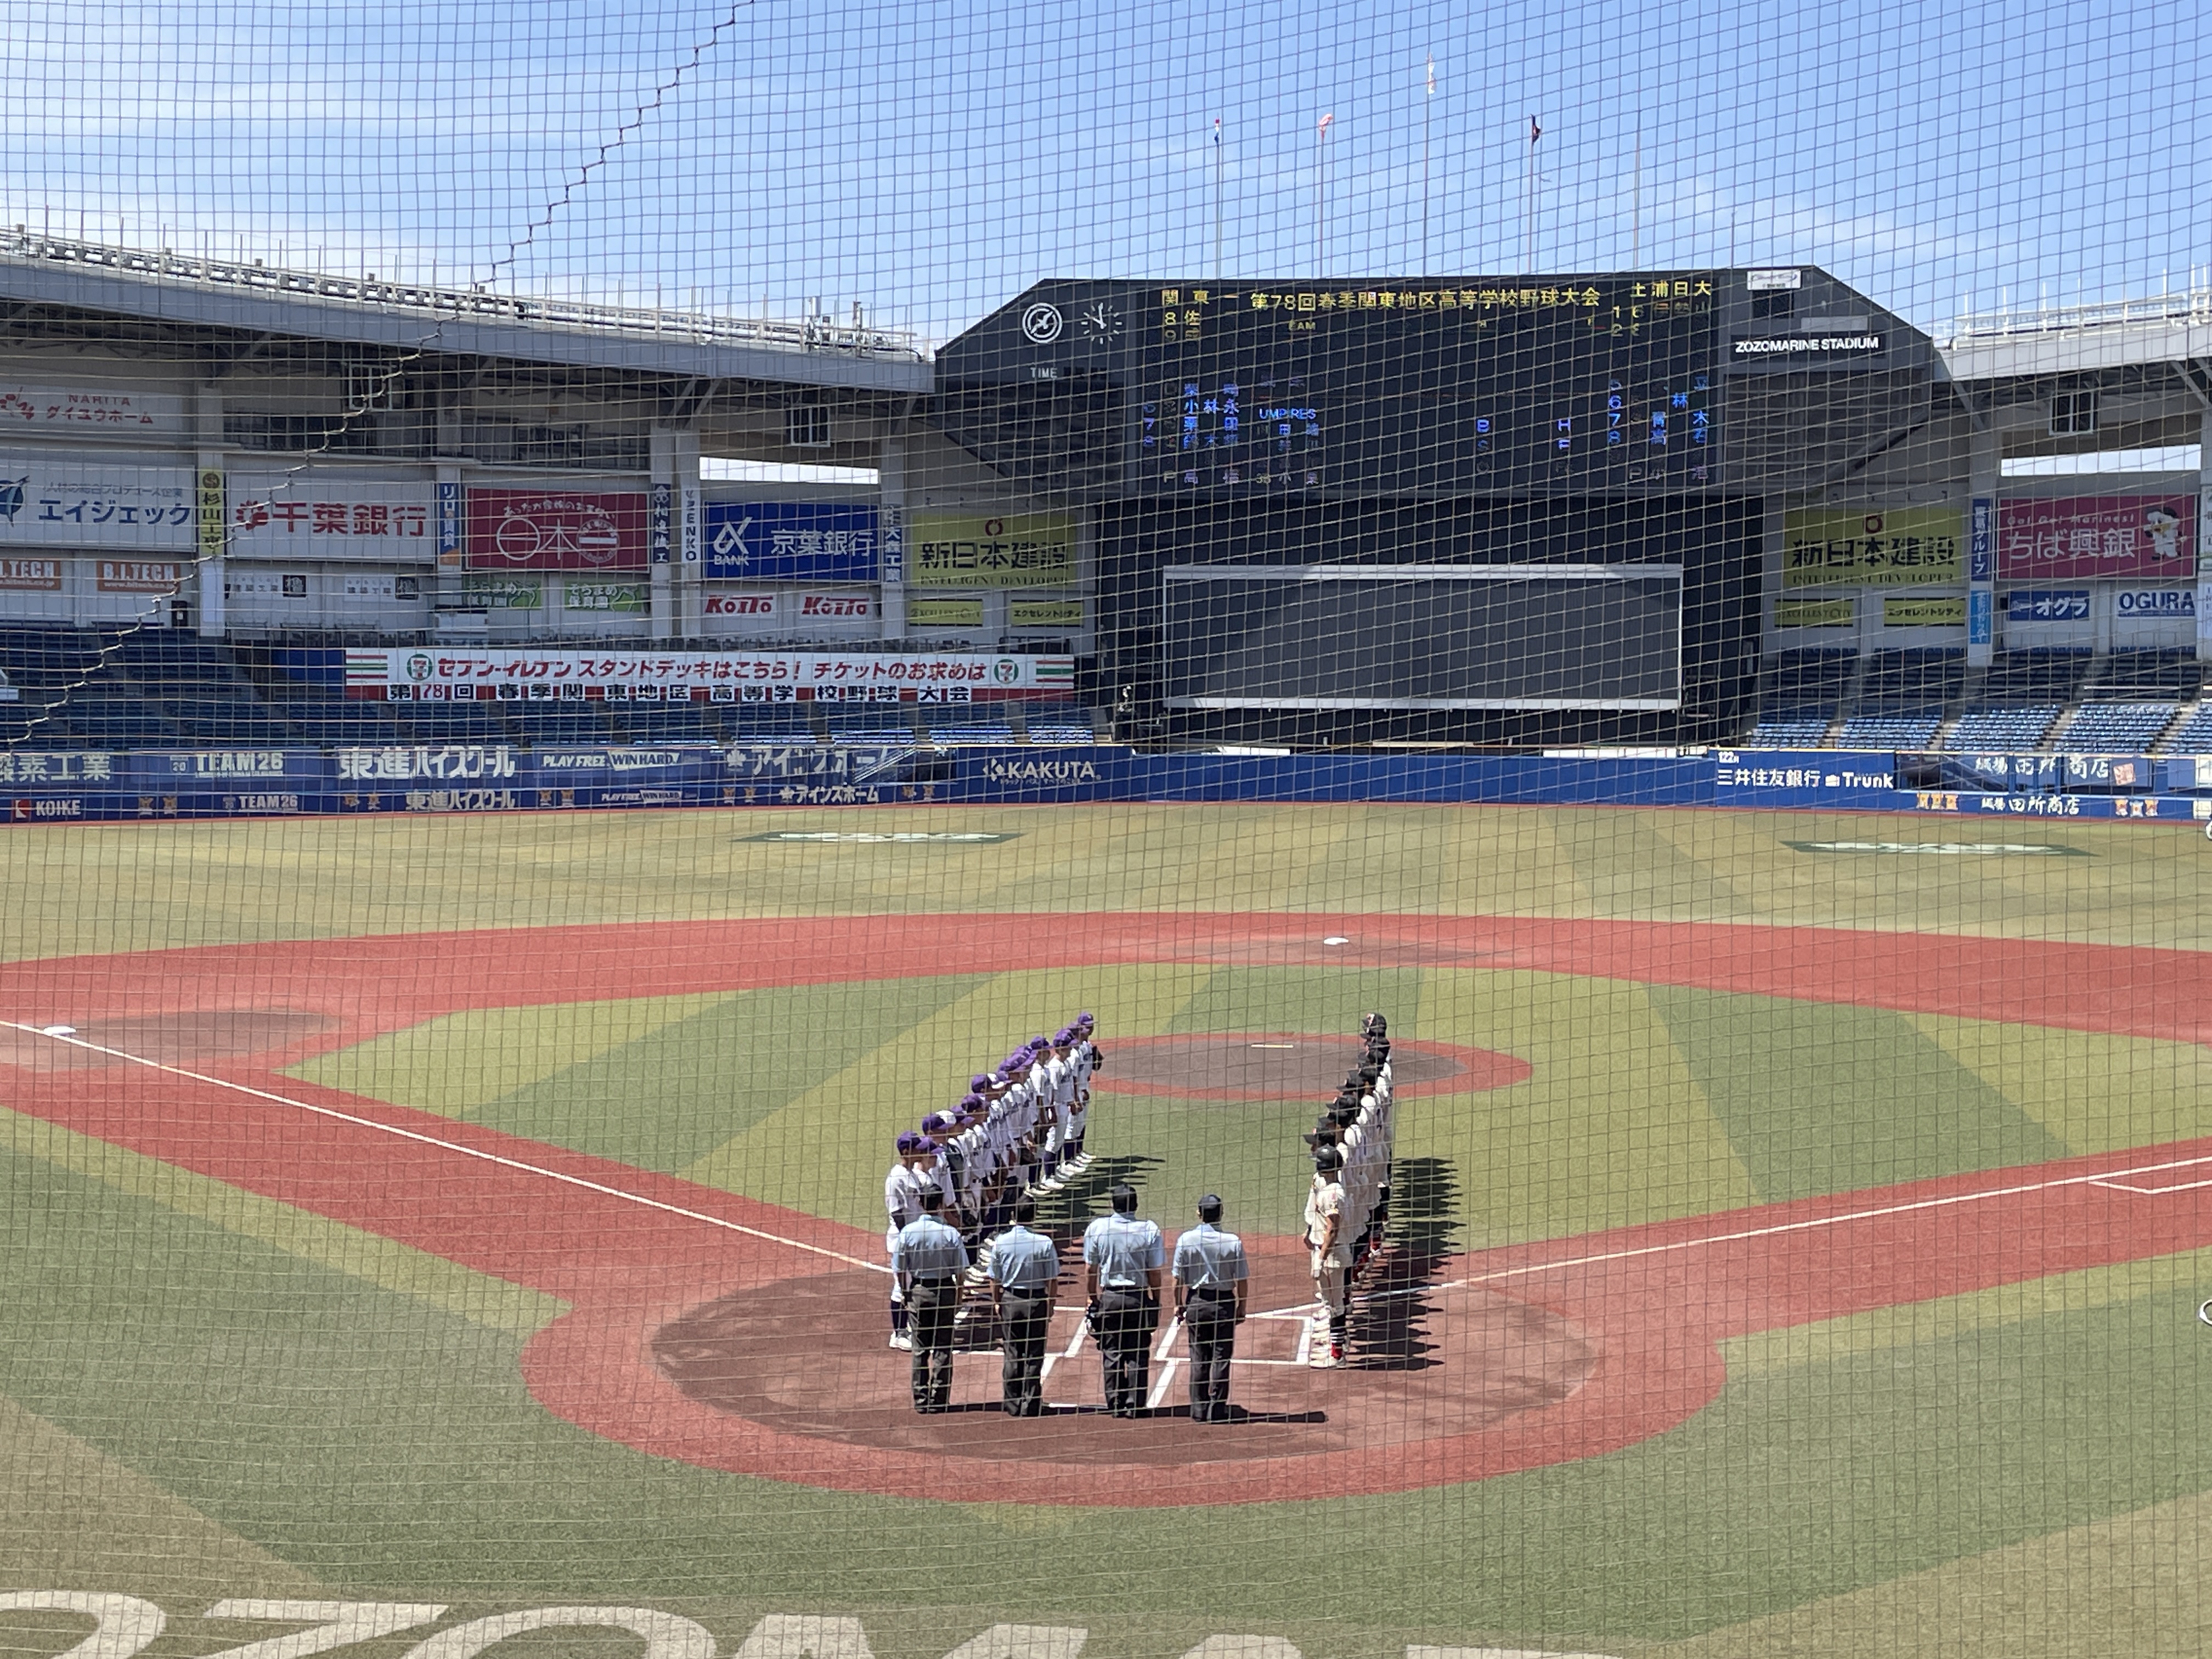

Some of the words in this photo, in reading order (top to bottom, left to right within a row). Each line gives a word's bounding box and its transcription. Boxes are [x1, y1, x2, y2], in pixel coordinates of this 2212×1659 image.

[1630, 280, 1711, 297] 土浦日大
[1735, 338, 1819, 353] ZOZOMARINE
[1821, 337, 1879, 349] STADIUM
[1030, 367, 1058, 379] TIME
[69, 394, 131, 407] NARITA
[1259, 408, 1317, 420] UMPRES
[1476, 419, 1489, 432] B
[1558, 419, 1571, 431] H
[38, 500, 190, 525] エイジェック
[273, 503, 426, 537] 千葉銀行
[770, 528, 874, 557] 京葉銀行
[1792, 537, 1955, 567] 新日本建設
[2006, 527, 2136, 560] ちば興銀
[714, 555, 749, 566] BANK
[919, 541, 1068, 570] 新日本建設
[2036, 596, 2087, 617] オグラ
[2119, 591, 2195, 610] OGURA
[814, 659, 986, 680] チケットのお求めは
[338, 746, 515, 779] 東進ハイスクール
[542, 755, 574, 767] PLAY
[612, 752, 637, 766] WIN
[1008, 761, 1095, 778] KAKUTA
[1718, 769, 1820, 788] 三井住友銀行
[1842, 771, 1893, 789] Trunk
[405, 789, 515, 810] 東進ハイスクール
[795, 785, 879, 804] アインズホーム
[36, 800, 81, 816] KOIKE
[2008, 795, 2080, 816] 田所商店
